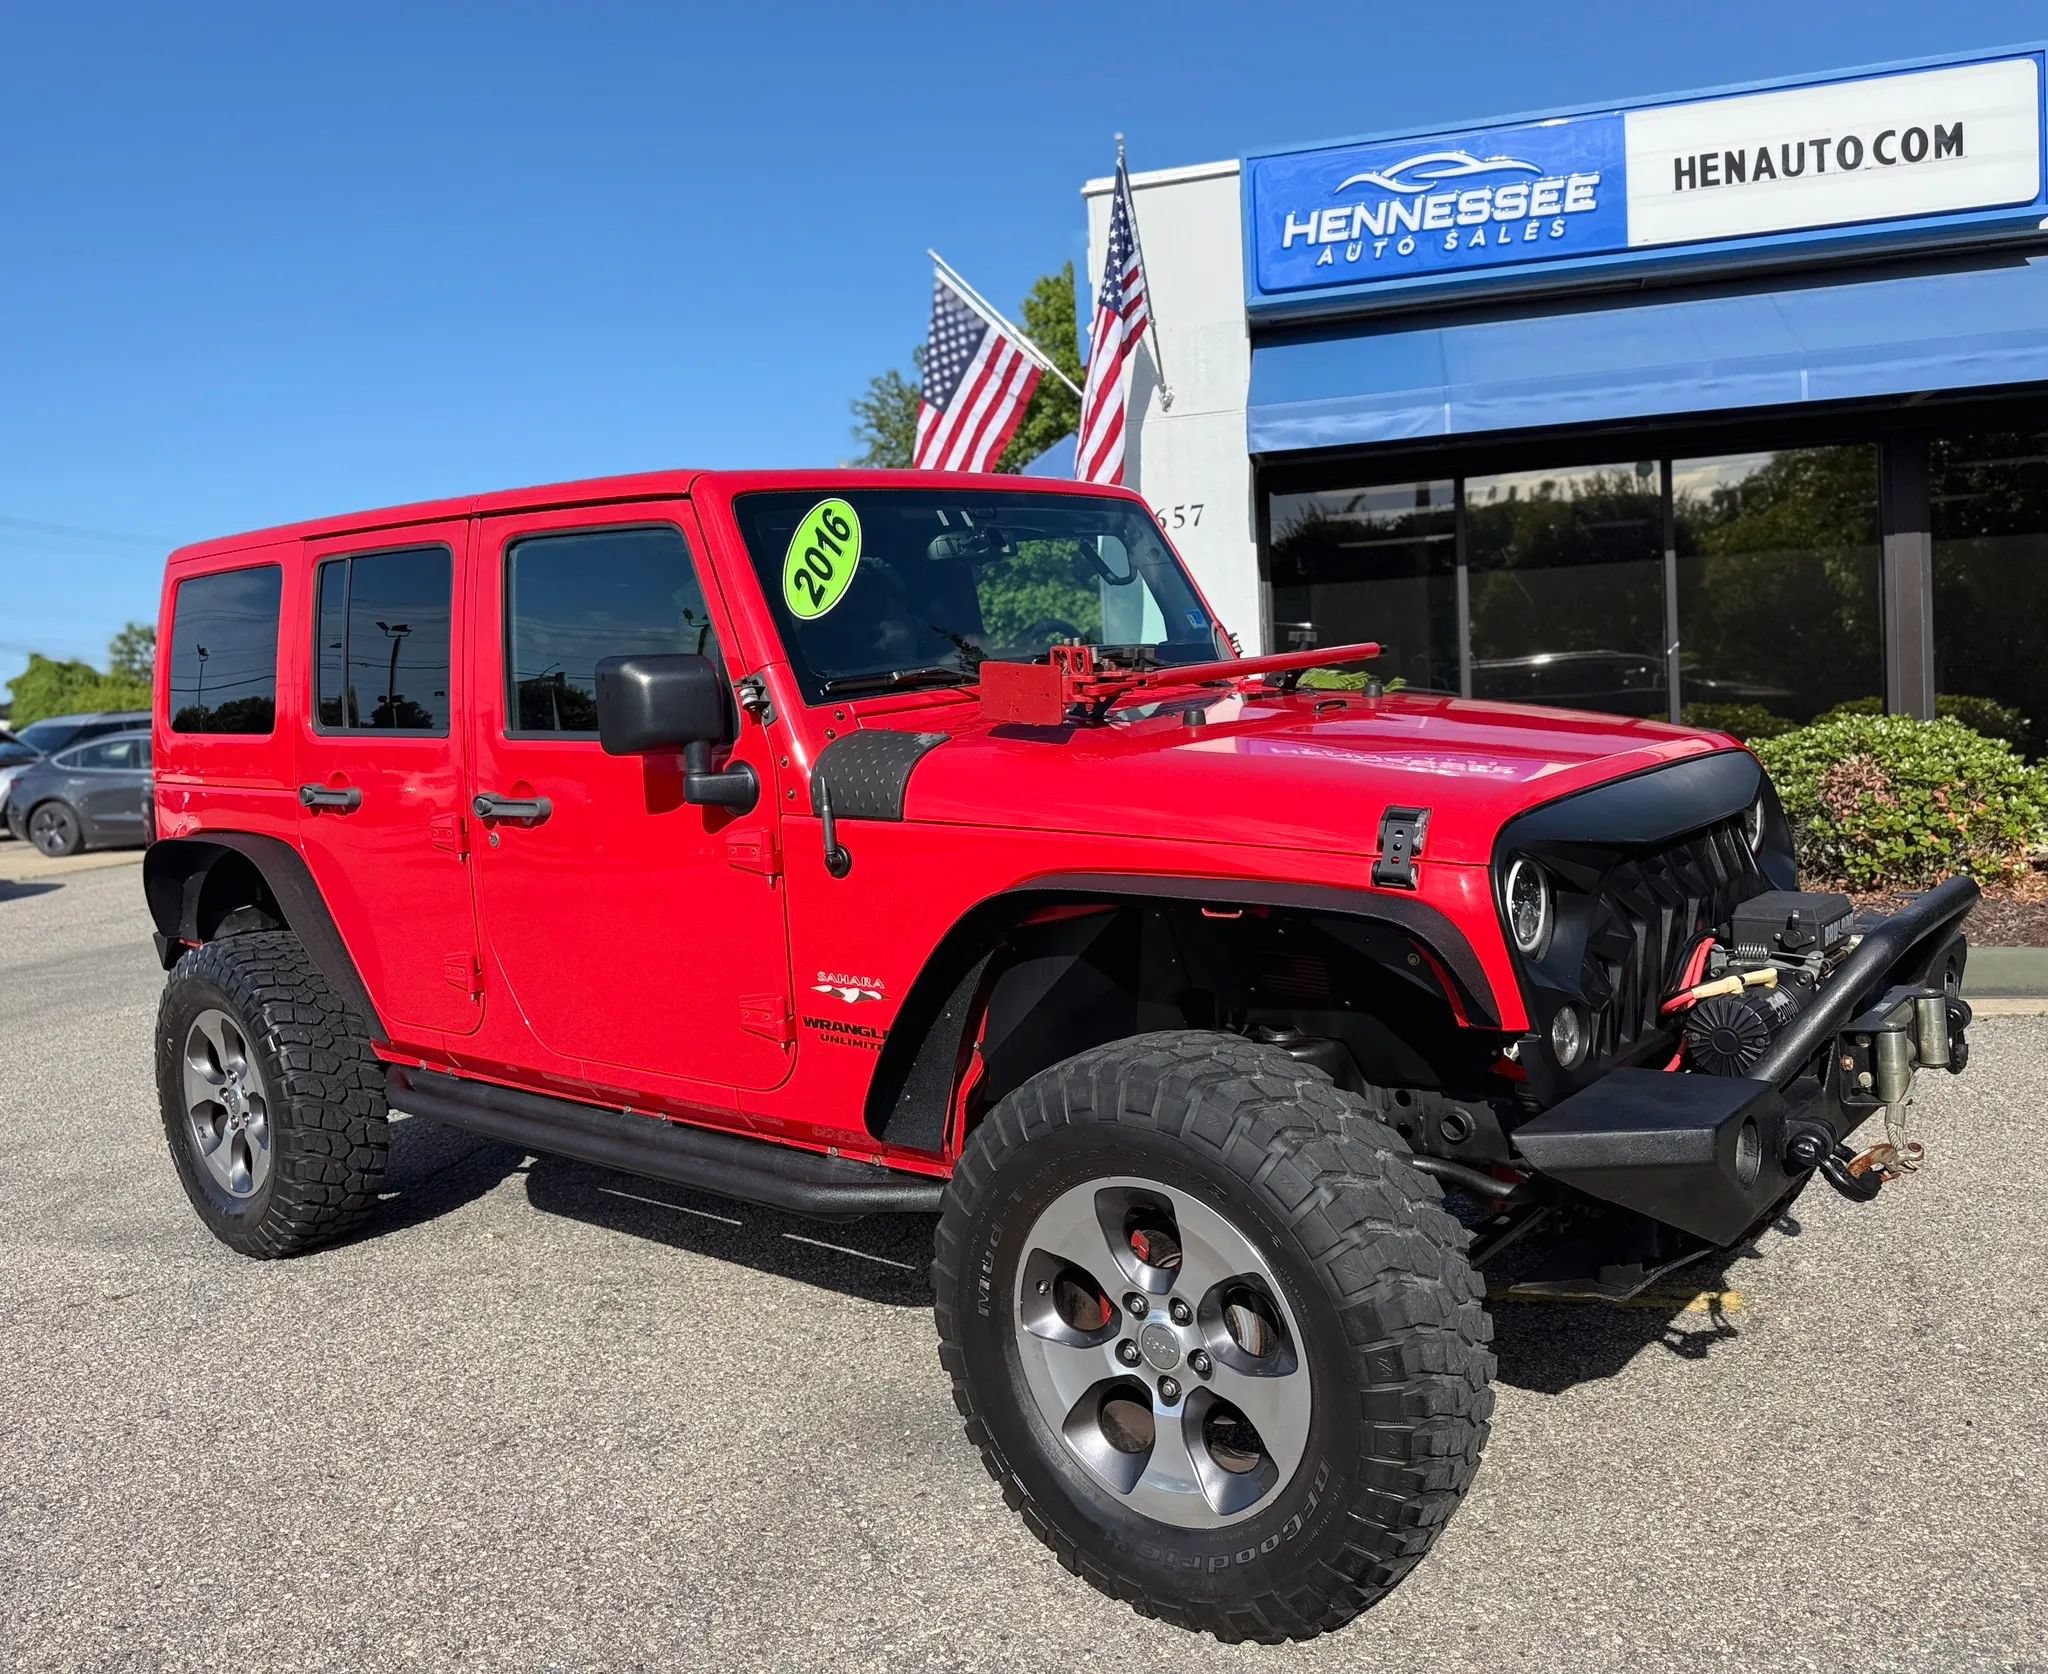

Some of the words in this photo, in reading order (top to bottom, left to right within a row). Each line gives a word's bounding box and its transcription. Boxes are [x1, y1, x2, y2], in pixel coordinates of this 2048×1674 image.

[1282, 171, 1600, 248] HENNESSEE
[1316, 234, 1416, 266] AUTO
[1443, 217, 1566, 250] SALES
[793, 507, 852, 609] 2016
[816, 970, 886, 989] SAHARA
